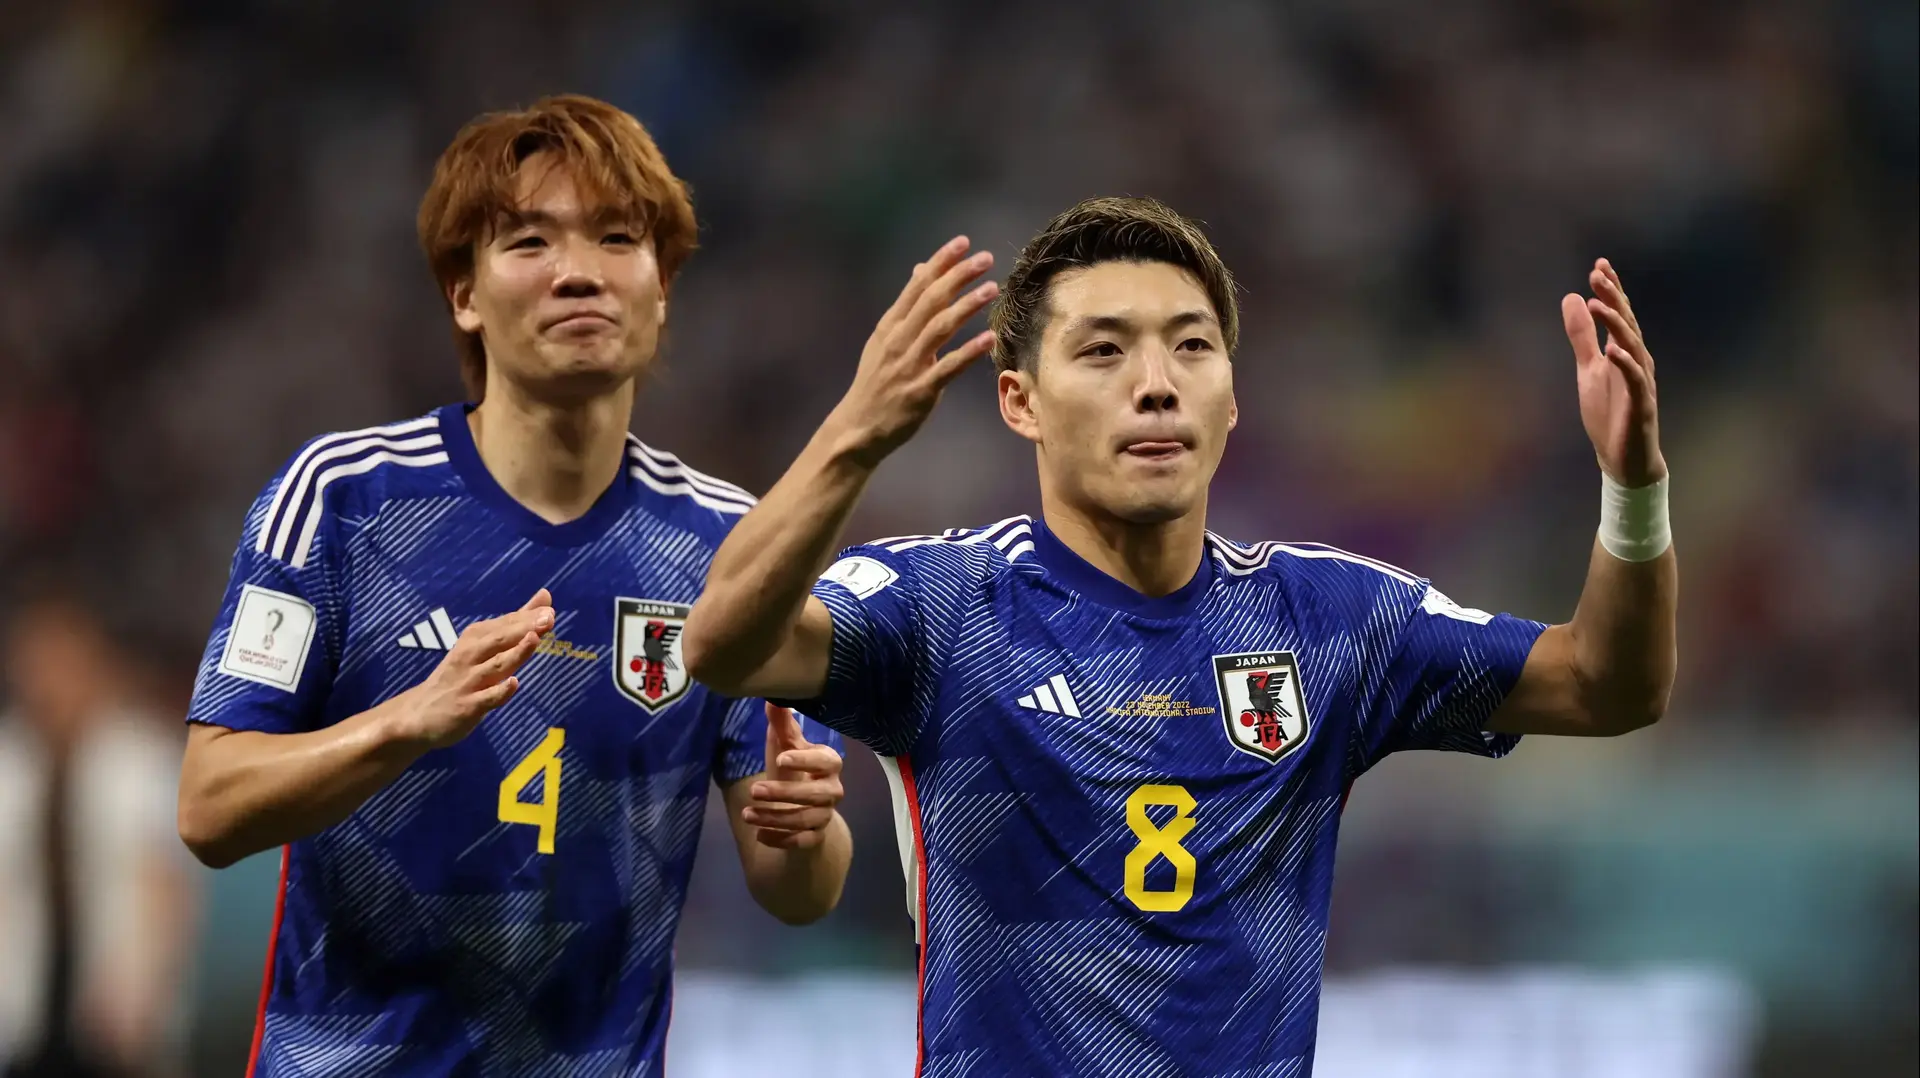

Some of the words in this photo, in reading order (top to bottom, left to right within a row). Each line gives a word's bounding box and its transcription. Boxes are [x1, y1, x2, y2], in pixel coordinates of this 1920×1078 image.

[636, 603, 676, 616] JAPAN
[1235, 655, 1276, 667] JAPAN
[637, 675, 670, 692] JFA
[1133, 708, 1184, 717] INTERNATIONAL
[1185, 706, 1216, 716] STADIUM
[1173, 701, 1190, 709] 2022
[1252, 725, 1289, 744] JFA
[497, 726, 566, 855] 4
[1124, 784, 1198, 912] 8
